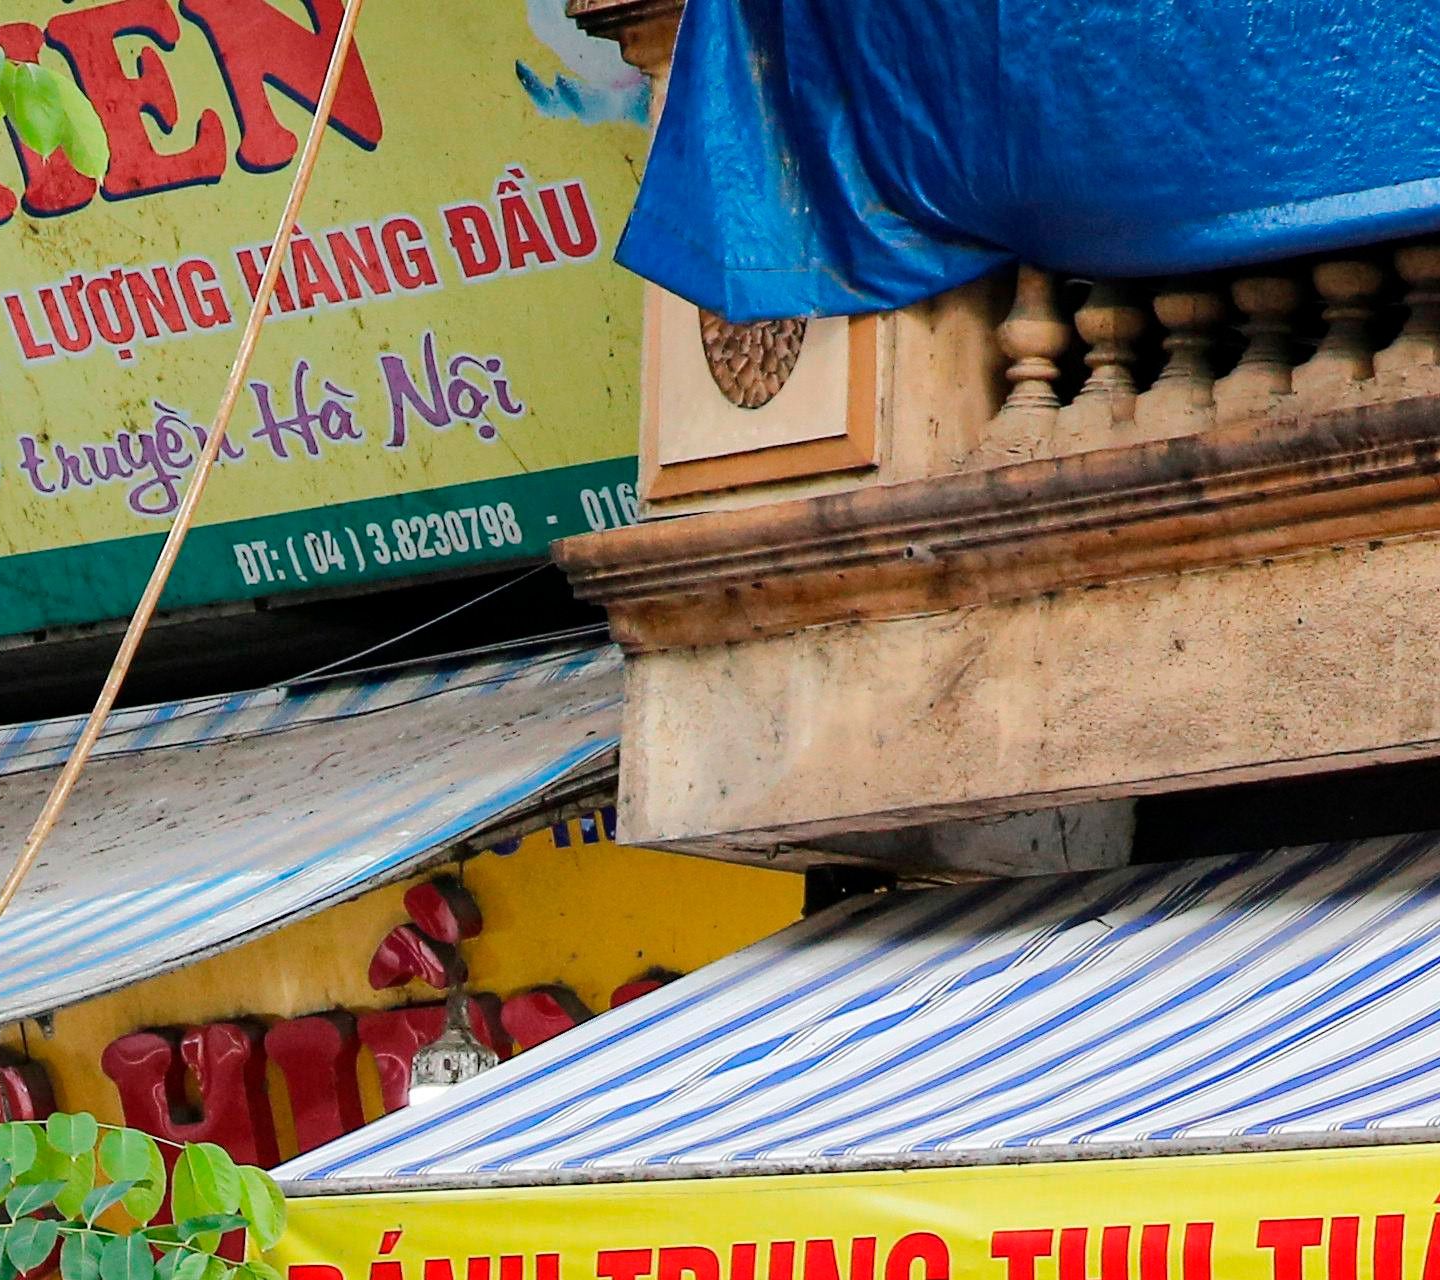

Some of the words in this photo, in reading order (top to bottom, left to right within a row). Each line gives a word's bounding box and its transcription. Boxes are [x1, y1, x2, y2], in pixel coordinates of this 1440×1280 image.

[5, 259, 233, 361] LƯỢNG
[239, 214, 430, 320] HÀNG
[449, 167, 600, 280] ĐẦU
[20, 401, 242, 519] truyền
[251, 359, 365, 460] Hà
[384, 330, 525, 451] Nội
[233, 541, 286, 587] ĐT:
[366, 501, 523, 567] 3.8230798
[580, 481, 639, 533] 016
